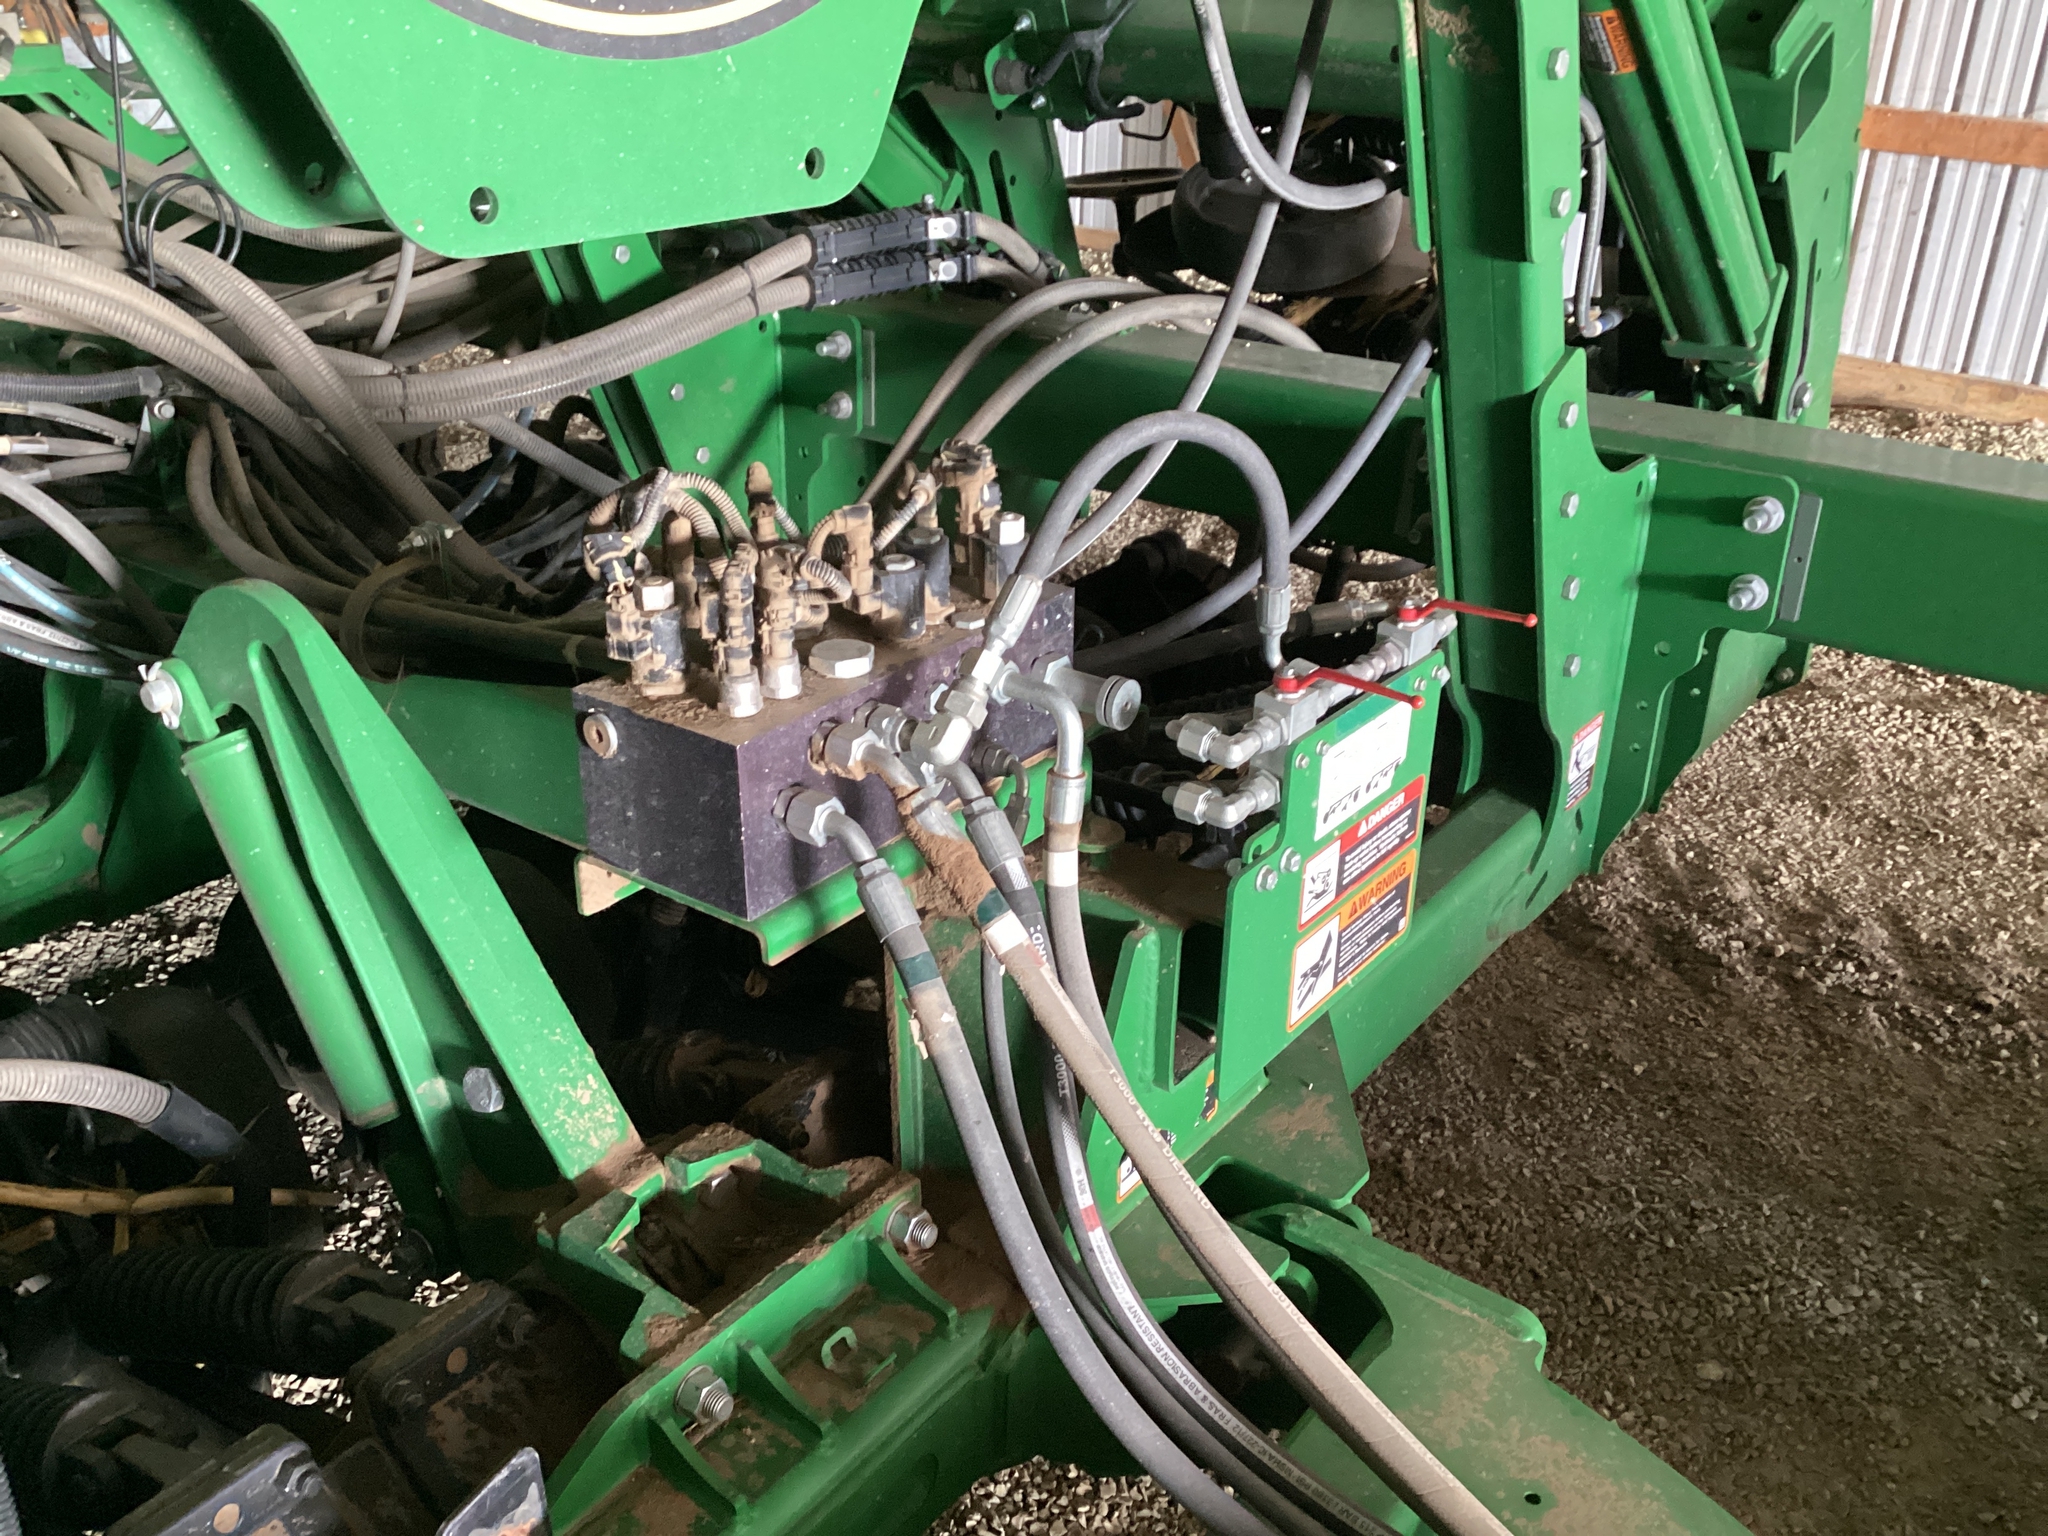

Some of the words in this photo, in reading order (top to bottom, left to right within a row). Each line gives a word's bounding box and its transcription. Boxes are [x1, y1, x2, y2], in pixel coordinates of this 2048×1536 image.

[1609, 24, 1637, 69] WARNING
[1366, 791, 1406, 832] DANGER
[1357, 861, 1407, 911] WARNING
[1109, 1067, 1135, 1106] T3000
[1162, 1143, 1212, 1211] DIEHARD
[1128, 1304, 1165, 1353] RESISTANT
[1160, 1352, 1202, 1396] ABRASION
[1207, 1403, 1232, 1426] FRAS
